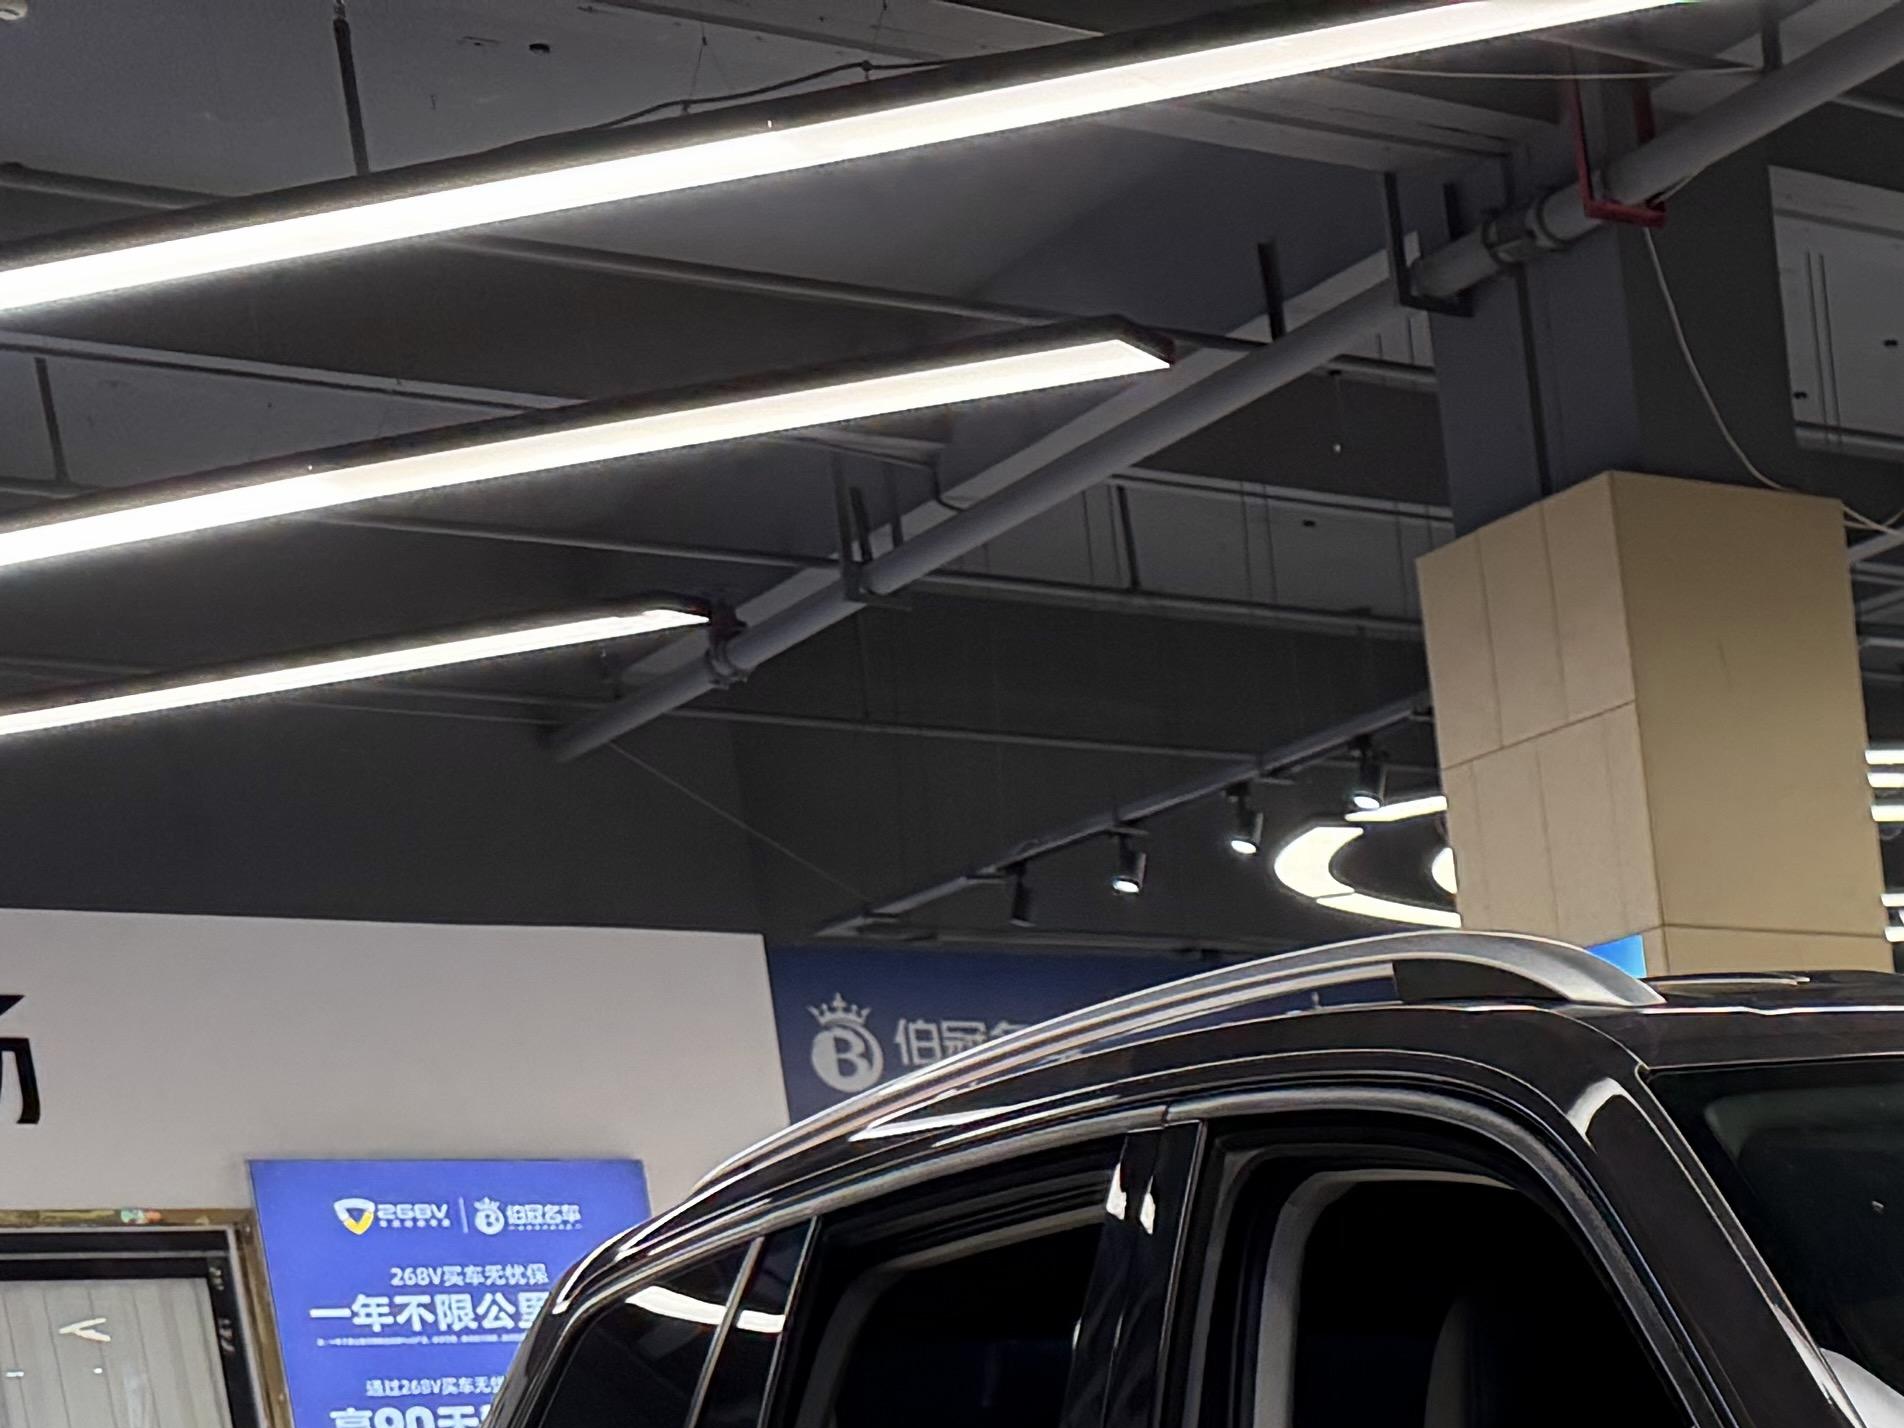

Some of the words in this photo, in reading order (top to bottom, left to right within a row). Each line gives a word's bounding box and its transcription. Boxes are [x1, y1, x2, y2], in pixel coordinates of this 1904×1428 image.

[893, 1018, 1028, 1067] 伯冠
[309, 1292, 551, 1333] 一年不限公里
